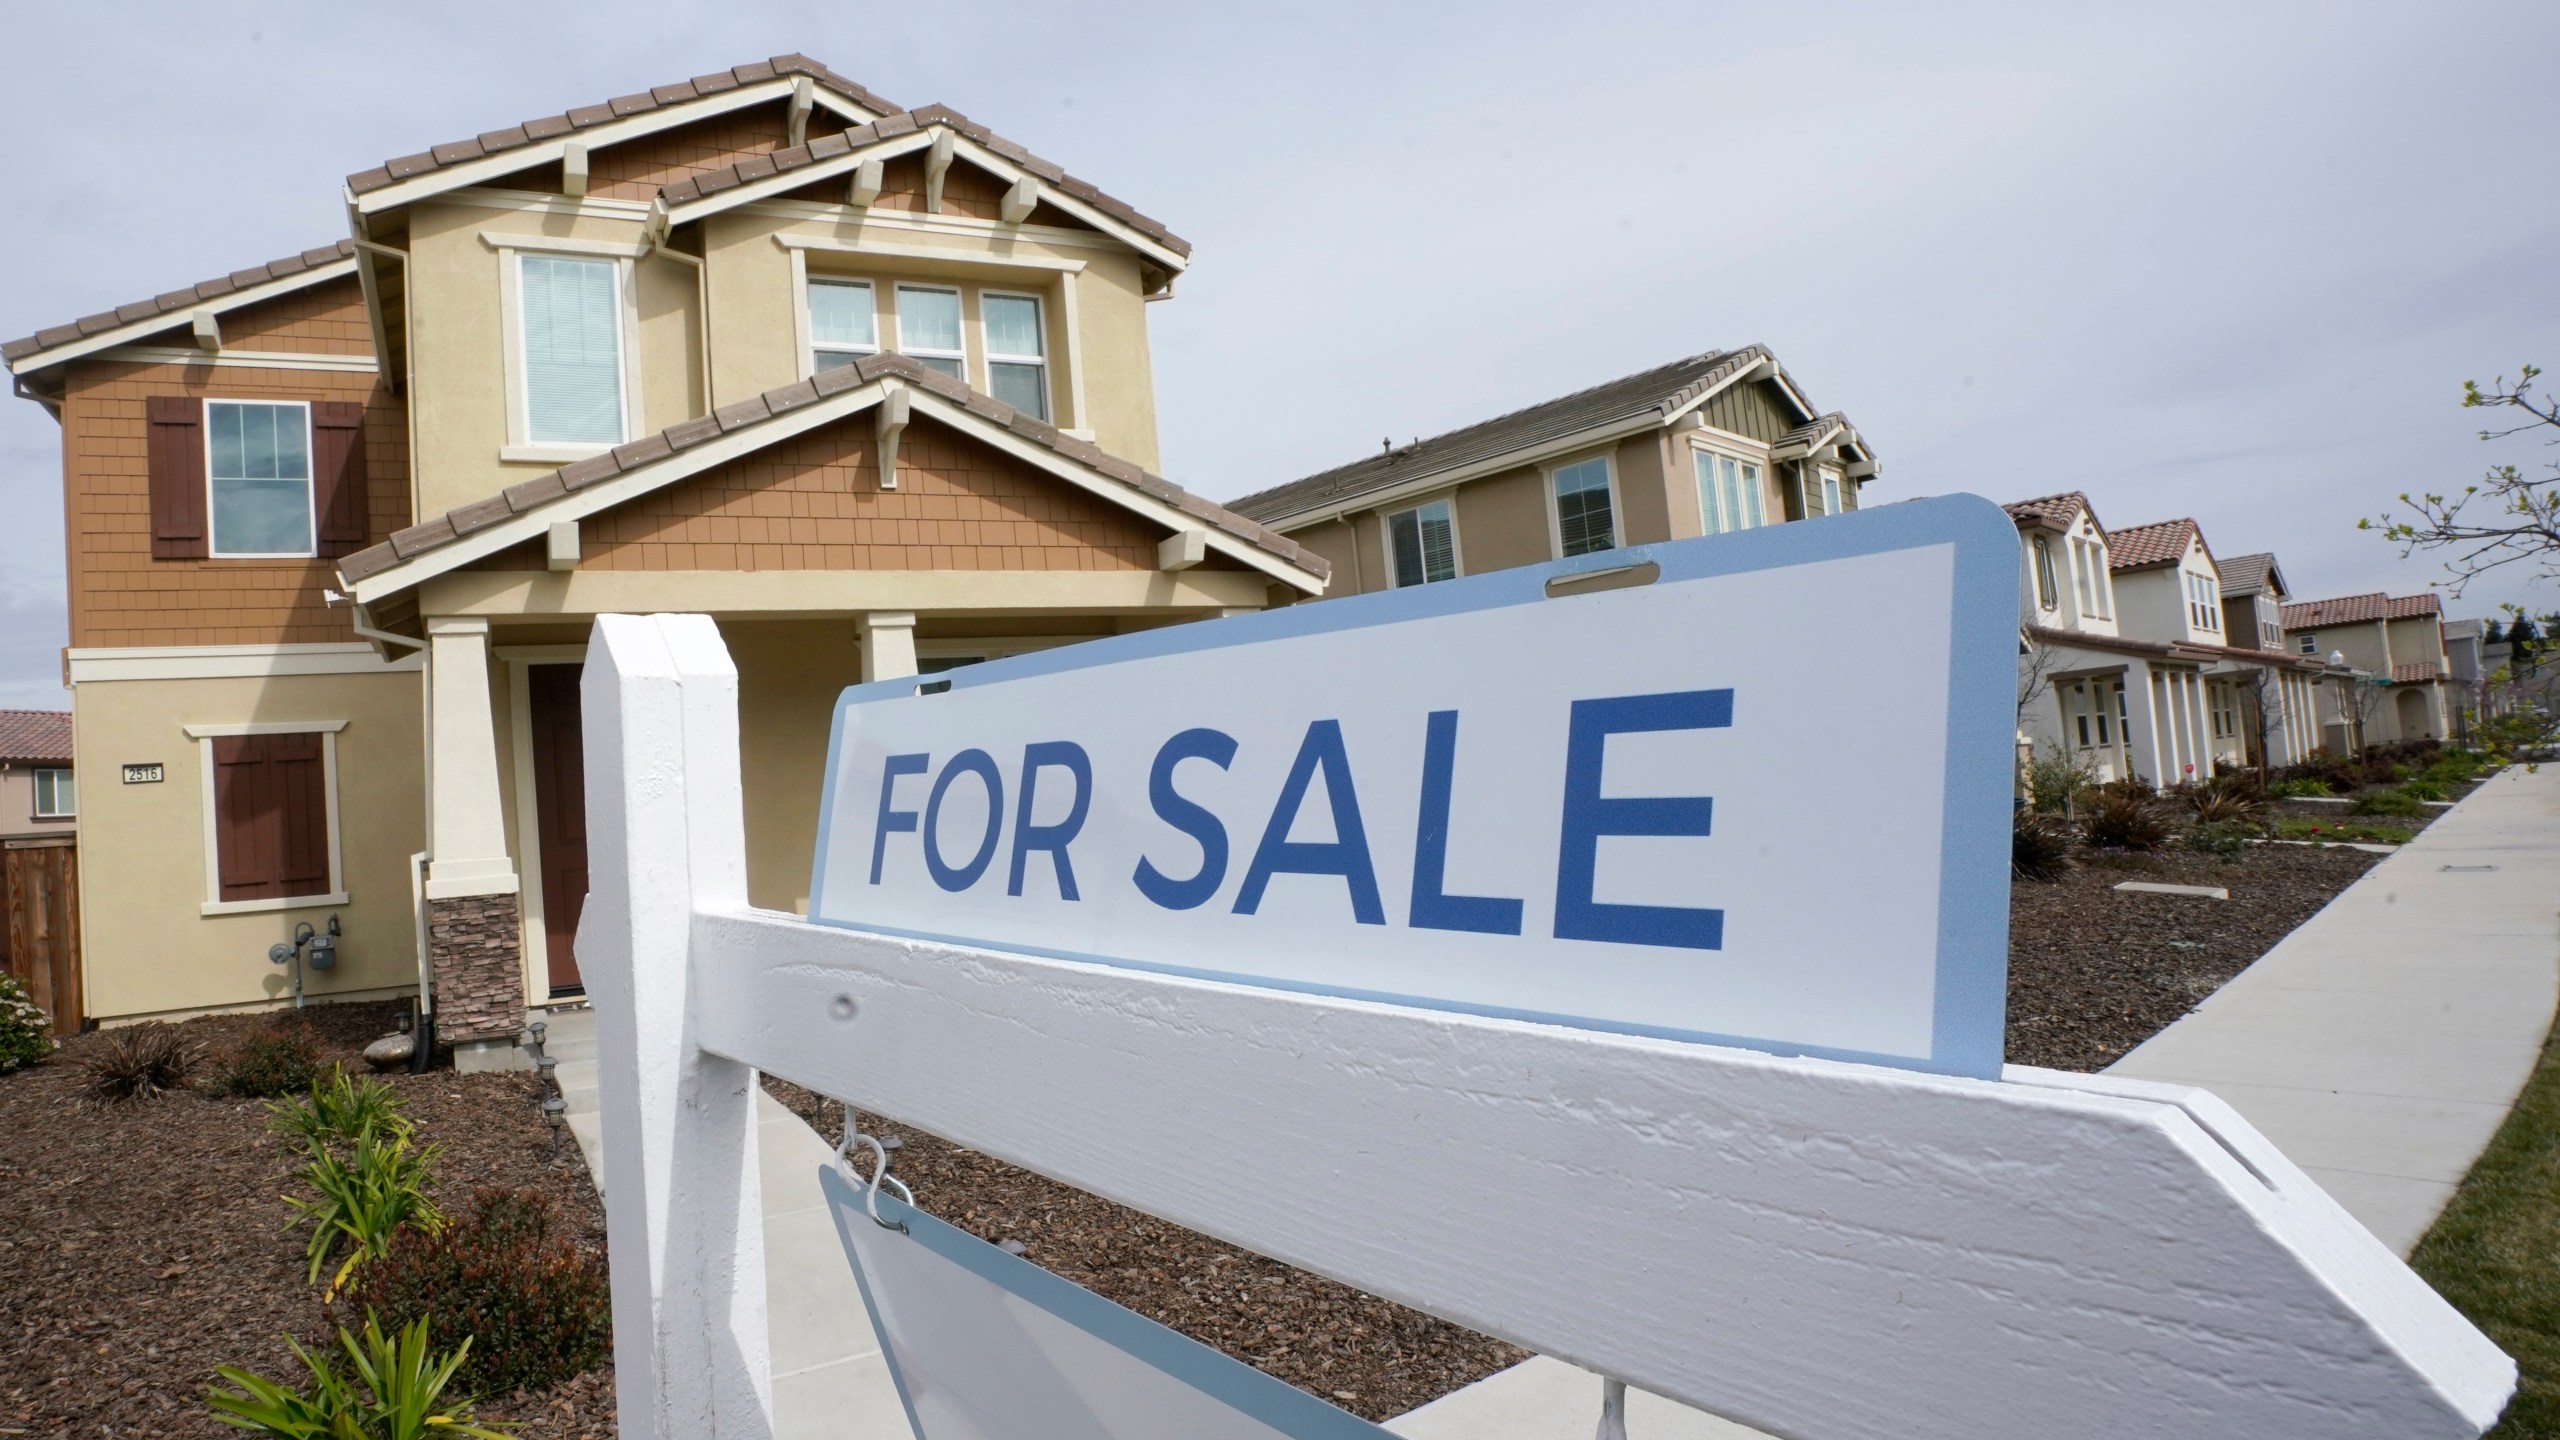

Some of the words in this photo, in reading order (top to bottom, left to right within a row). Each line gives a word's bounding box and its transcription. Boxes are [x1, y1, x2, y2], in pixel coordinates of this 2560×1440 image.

[129, 767, 157, 781] 2516
[869, 740, 1093, 902] FOR
[1132, 687, 1735, 952] SALE
